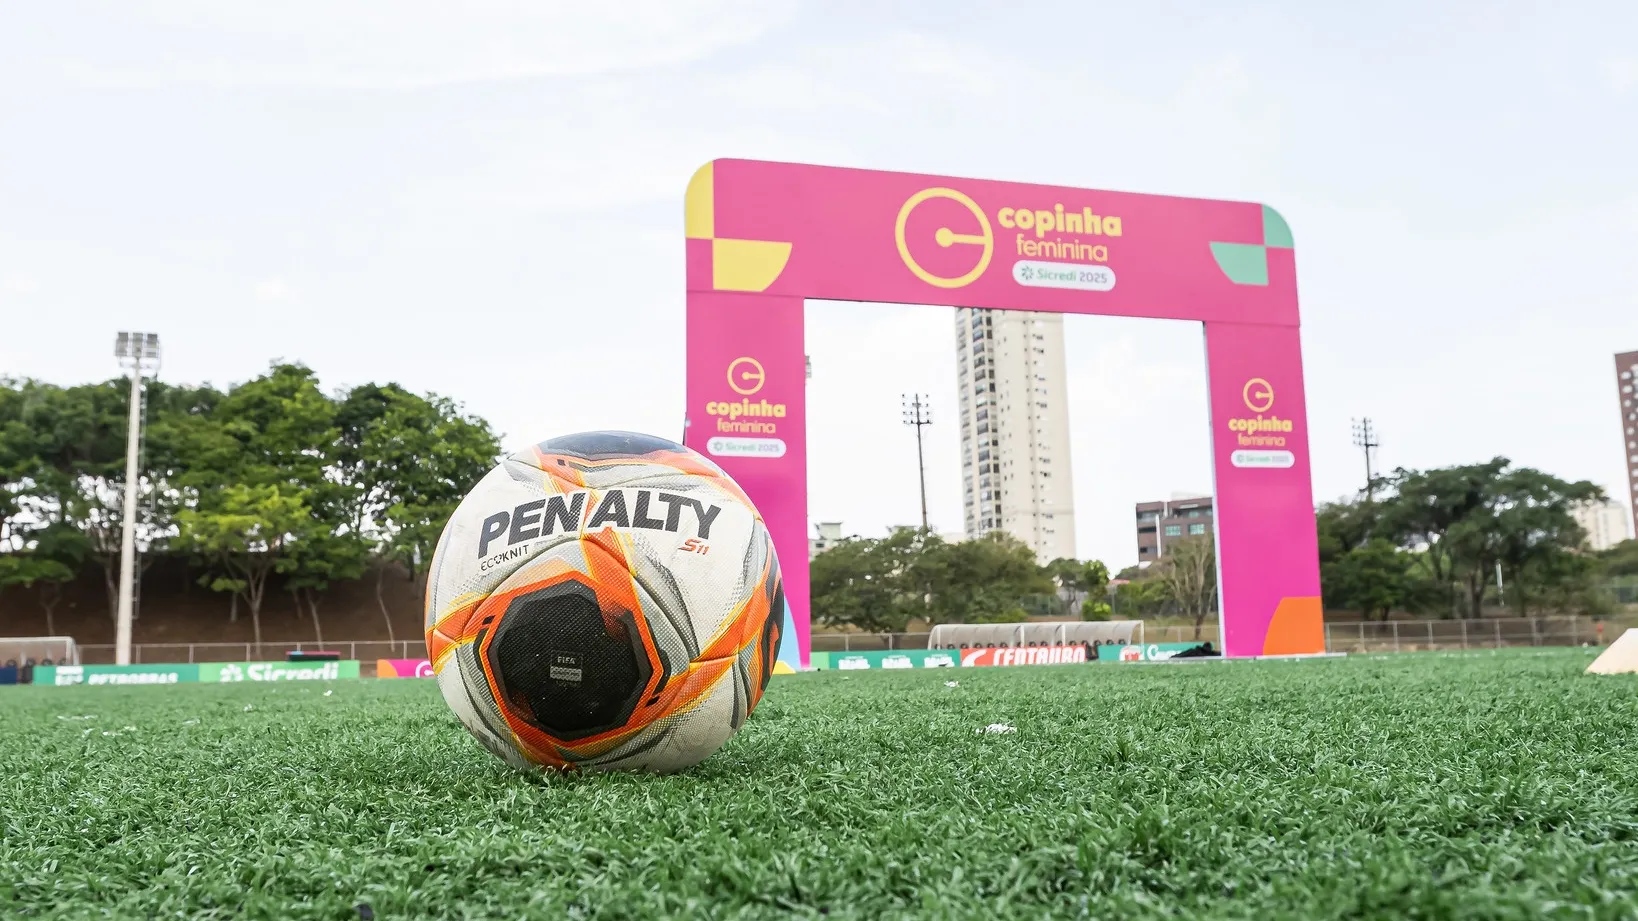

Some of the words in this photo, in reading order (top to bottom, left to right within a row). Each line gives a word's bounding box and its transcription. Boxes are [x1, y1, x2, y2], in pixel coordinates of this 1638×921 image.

[997, 203, 1122, 237] copinha
[1016, 233, 1108, 262] feminina
[1036, 268, 1077, 282] Sicredi
[1079, 271, 1108, 284] 2025
[706, 398, 786, 421] copinha
[717, 418, 776, 434] feminina
[1228, 414, 1293, 435] copinha
[477, 489, 722, 560] PENALTY
[677, 538, 710, 556] S11
[557, 656, 576, 665] FIFA
[992, 647, 1086, 666] CENTAURO
[247, 662, 340, 681] Sicredi
